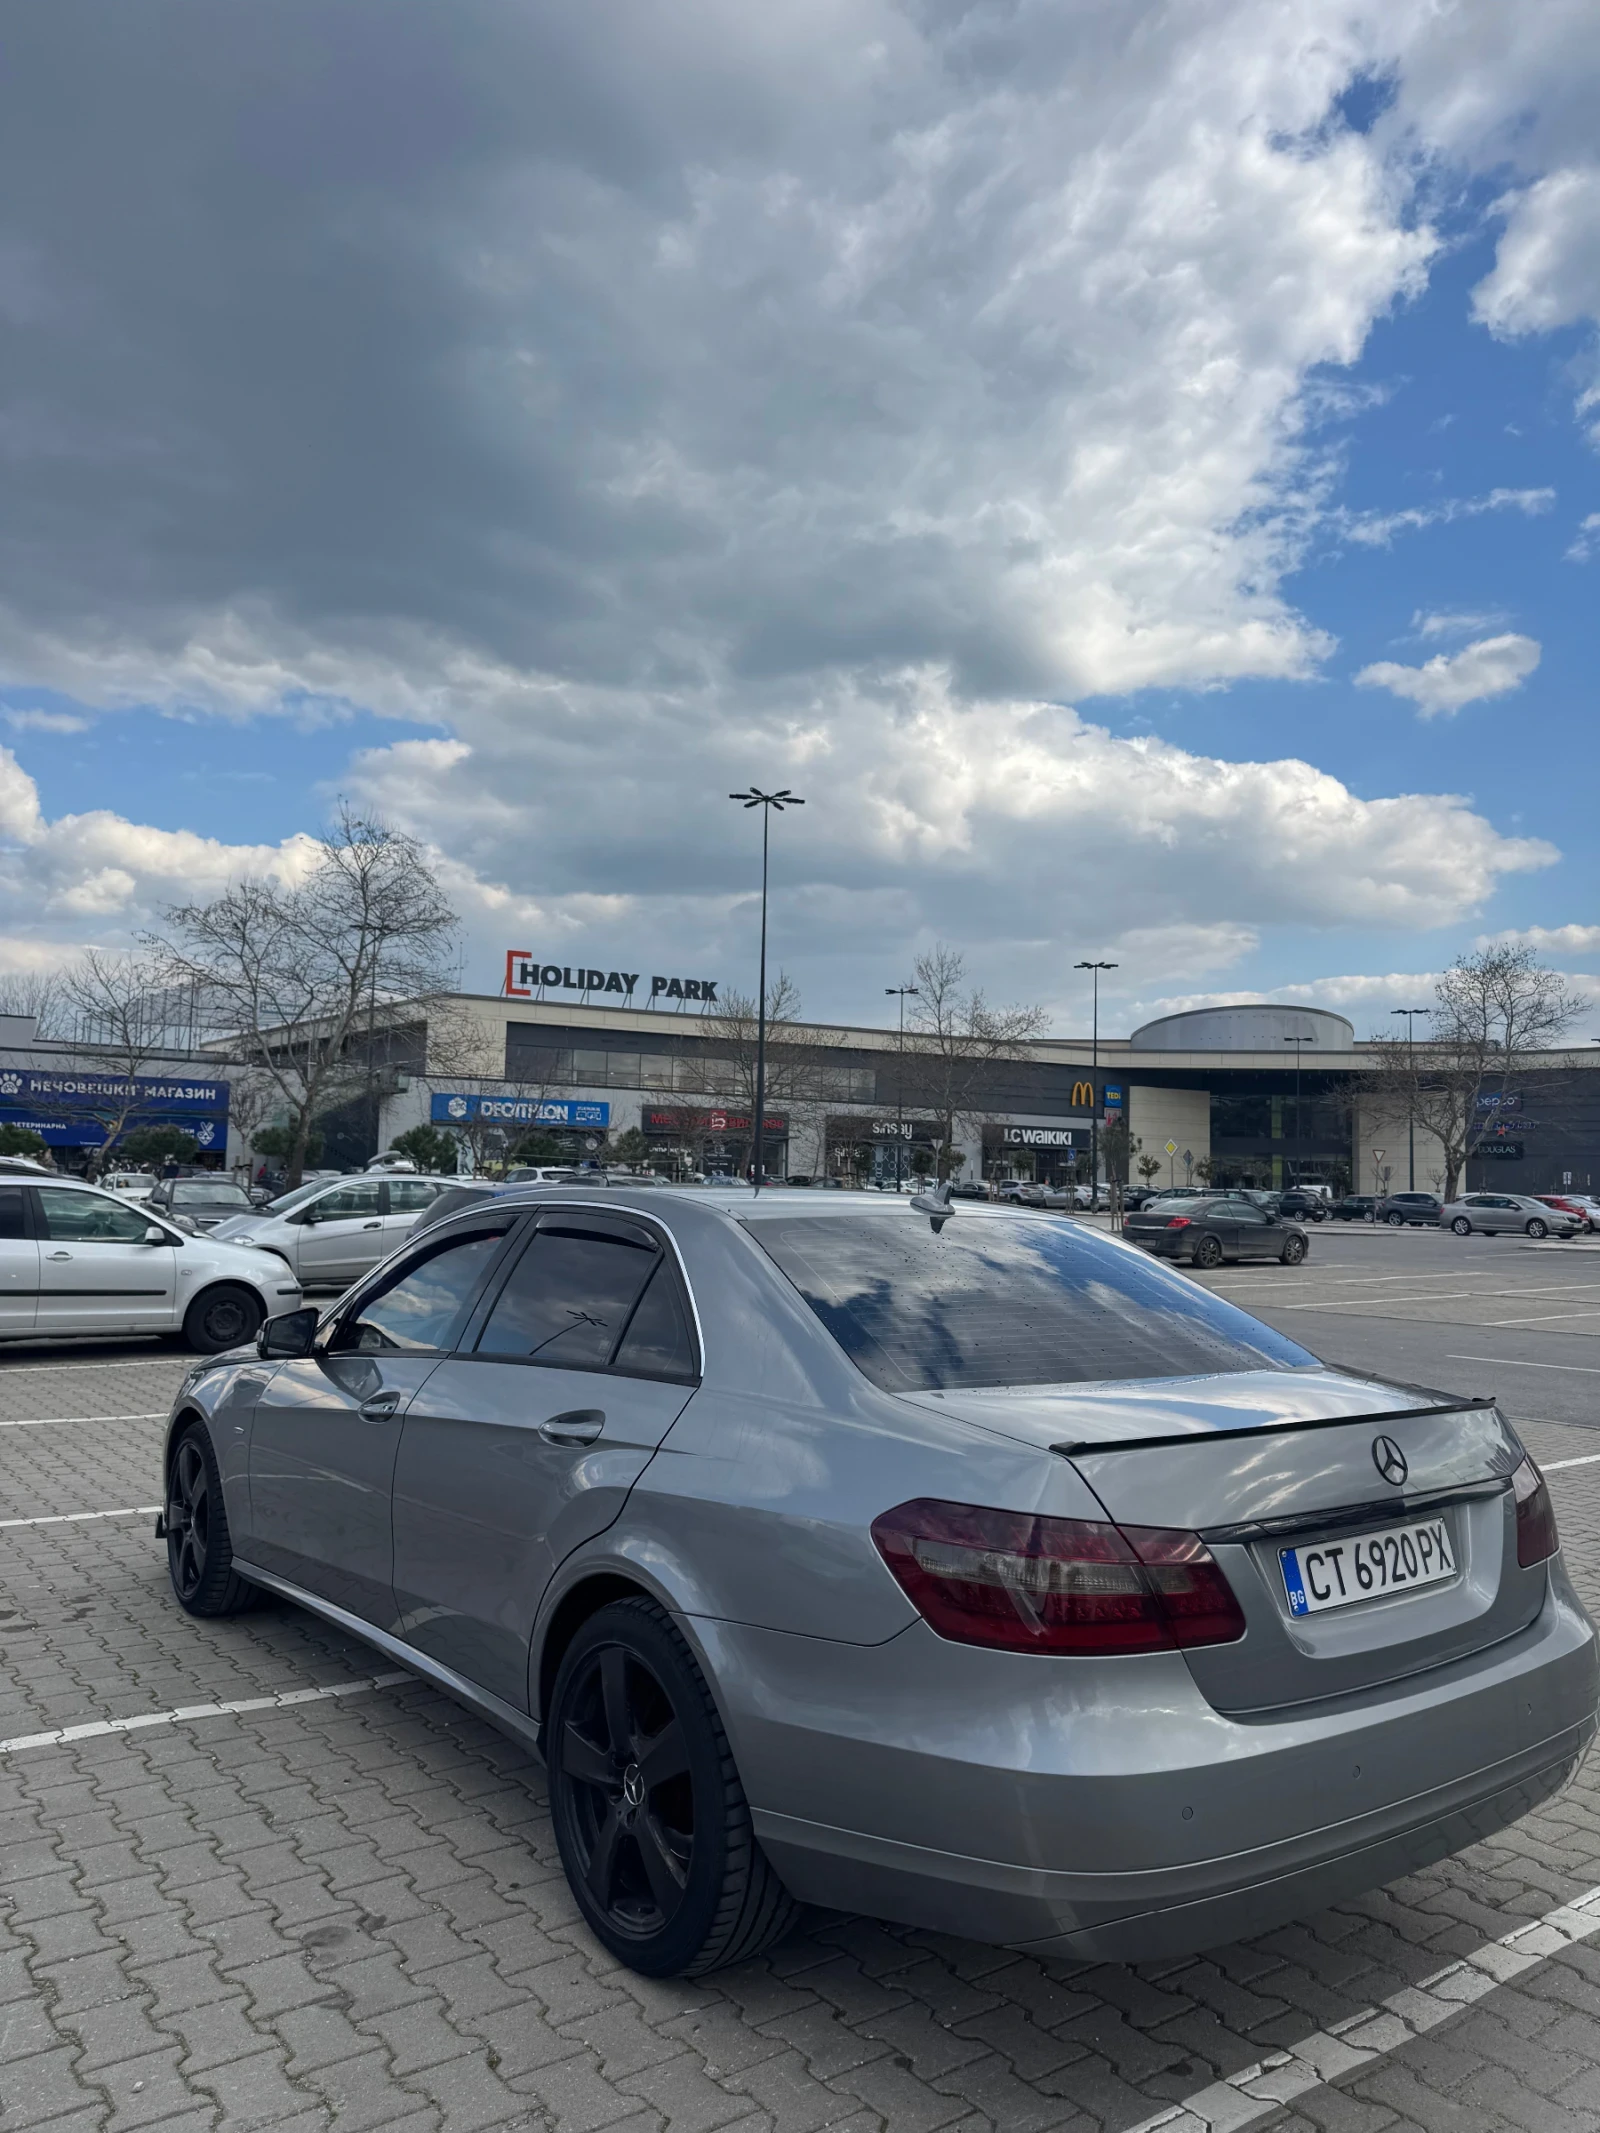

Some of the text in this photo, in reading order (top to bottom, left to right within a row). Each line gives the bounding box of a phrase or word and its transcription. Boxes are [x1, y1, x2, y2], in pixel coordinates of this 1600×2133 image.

[520, 963, 718, 1001] HOLIDAY PARK
[144, 1086, 216, 1100] МАГАЗИН
[1003, 1127, 1021, 1143] LC
[1478, 1145, 1516, 1154] DOUGLAS
[1306, 1524, 1452, 1601] CT 6920 PX
[1289, 1589, 1305, 1606] BG
